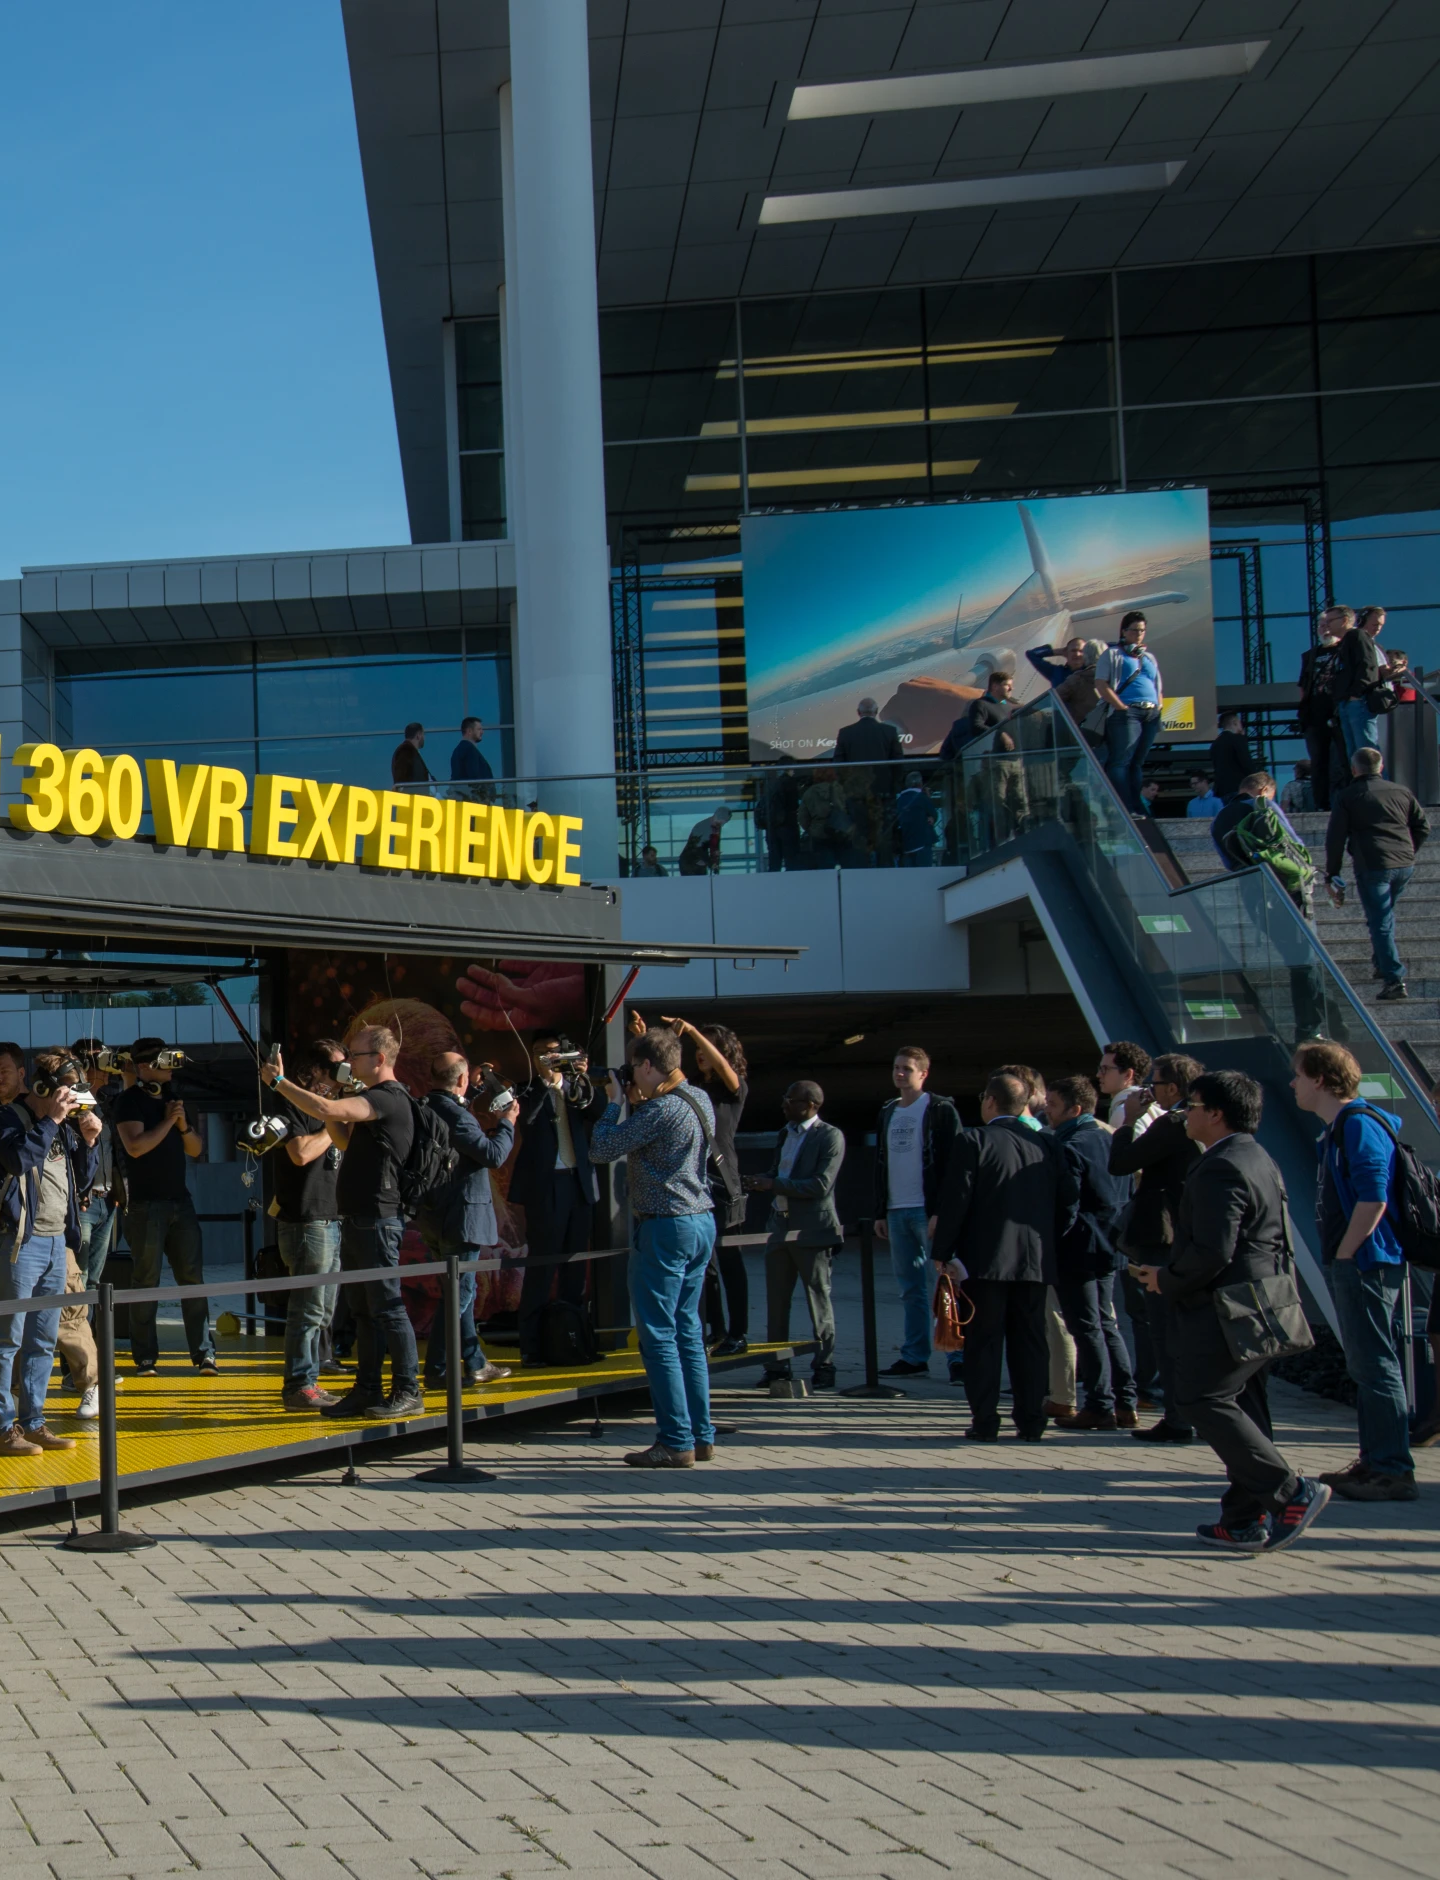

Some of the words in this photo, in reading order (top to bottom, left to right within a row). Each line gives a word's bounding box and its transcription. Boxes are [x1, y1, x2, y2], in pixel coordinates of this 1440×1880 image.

[770, 740, 795, 749] SHOT
[798, 739, 813, 748] ON
[9, 743, 143, 840] 360
[146, 759, 244, 852] VR
[250, 774, 583, 887] EXPERIENCE
